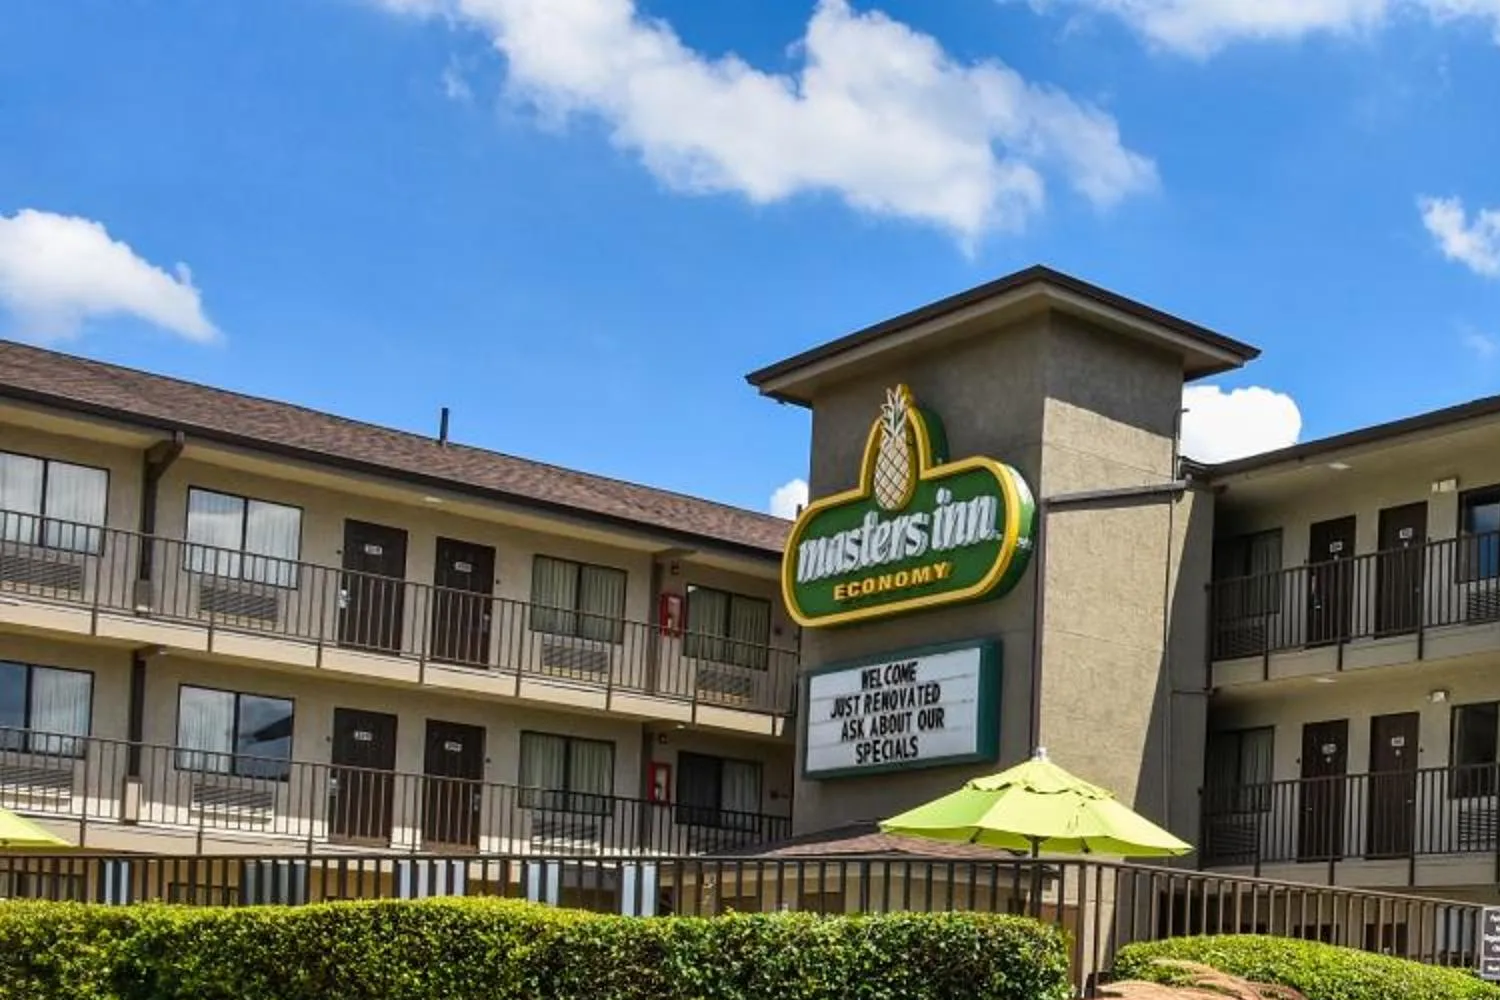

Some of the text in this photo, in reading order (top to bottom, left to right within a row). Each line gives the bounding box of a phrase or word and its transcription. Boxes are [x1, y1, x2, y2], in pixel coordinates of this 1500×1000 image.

[797, 488, 998, 584] masters inn
[834, 562, 950, 600] ECONOMY
[862, 661, 918, 690] WELCOME
[830, 682, 941, 718] JUST RENOVATED
[841, 707, 945, 742] ASK ABOUT OUR
[855, 736, 918, 764] SPECIALS
